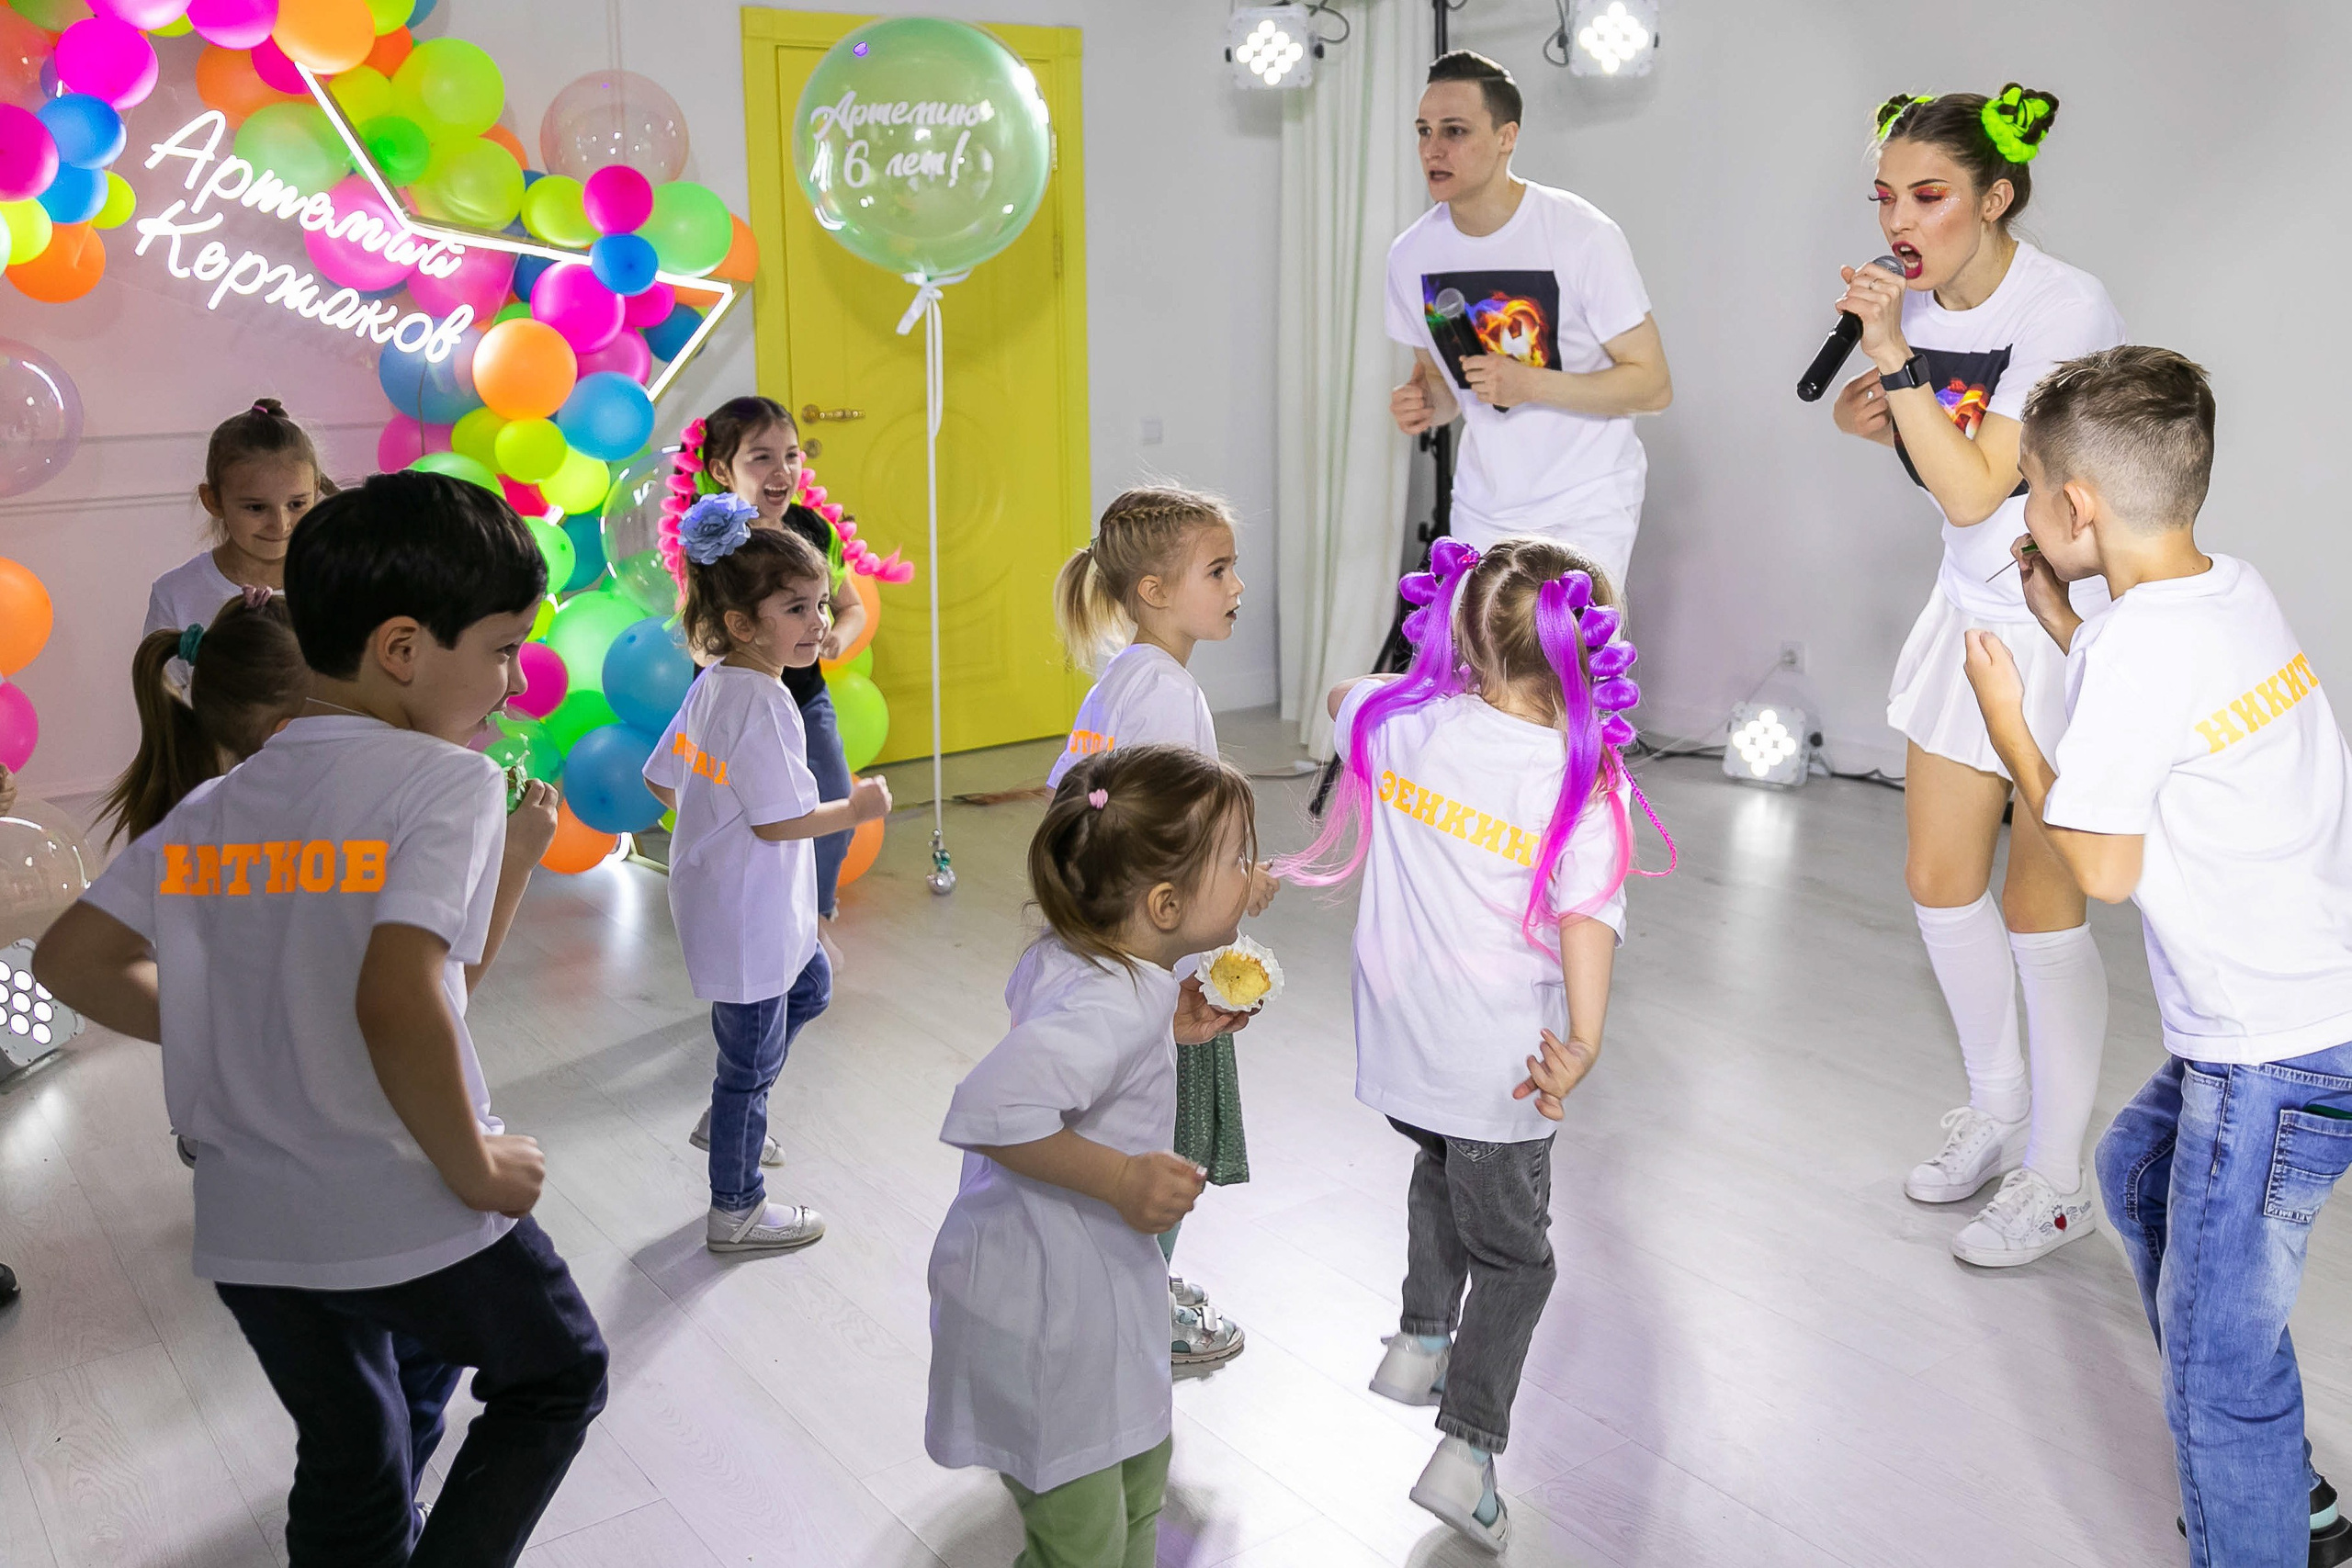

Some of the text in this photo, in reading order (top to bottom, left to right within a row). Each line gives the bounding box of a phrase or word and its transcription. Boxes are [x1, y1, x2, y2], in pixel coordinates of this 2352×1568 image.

[144, 109, 466, 278] Артемий
[843, 130, 971, 188] 6 лет!
[135, 199, 475, 363] Кержаков
